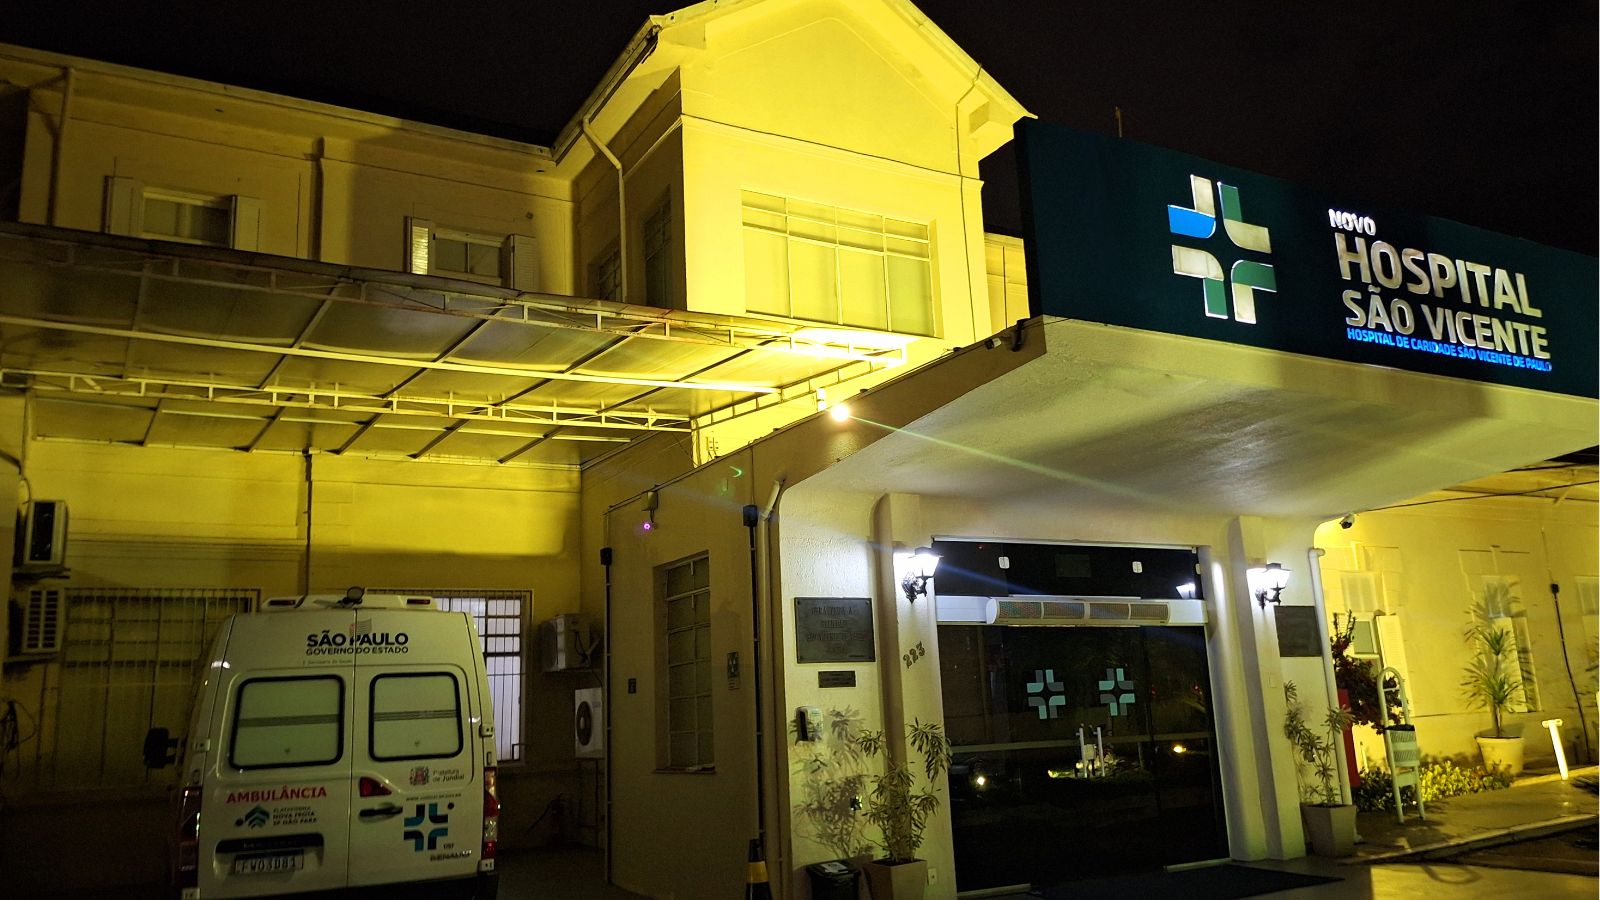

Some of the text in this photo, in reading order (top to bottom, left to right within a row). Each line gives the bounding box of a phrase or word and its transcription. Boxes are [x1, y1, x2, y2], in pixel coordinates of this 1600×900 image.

[1328, 208, 1377, 236] NOVO
[1334, 231, 1543, 318] HOSPITAL
[1342, 284, 1551, 360] SÃO VICENTE
[1346, 327, 1553, 373] HOSPITAL DE CARIDADE SÃO VICENTE DE PAULO
[305, 646, 409, 656] GOVERNO DO ESTADO
[306, 629, 409, 648] SÃO PAULO
[902, 640, 926, 670] 223
[225, 785, 327, 804] AMBULÂNCIA
